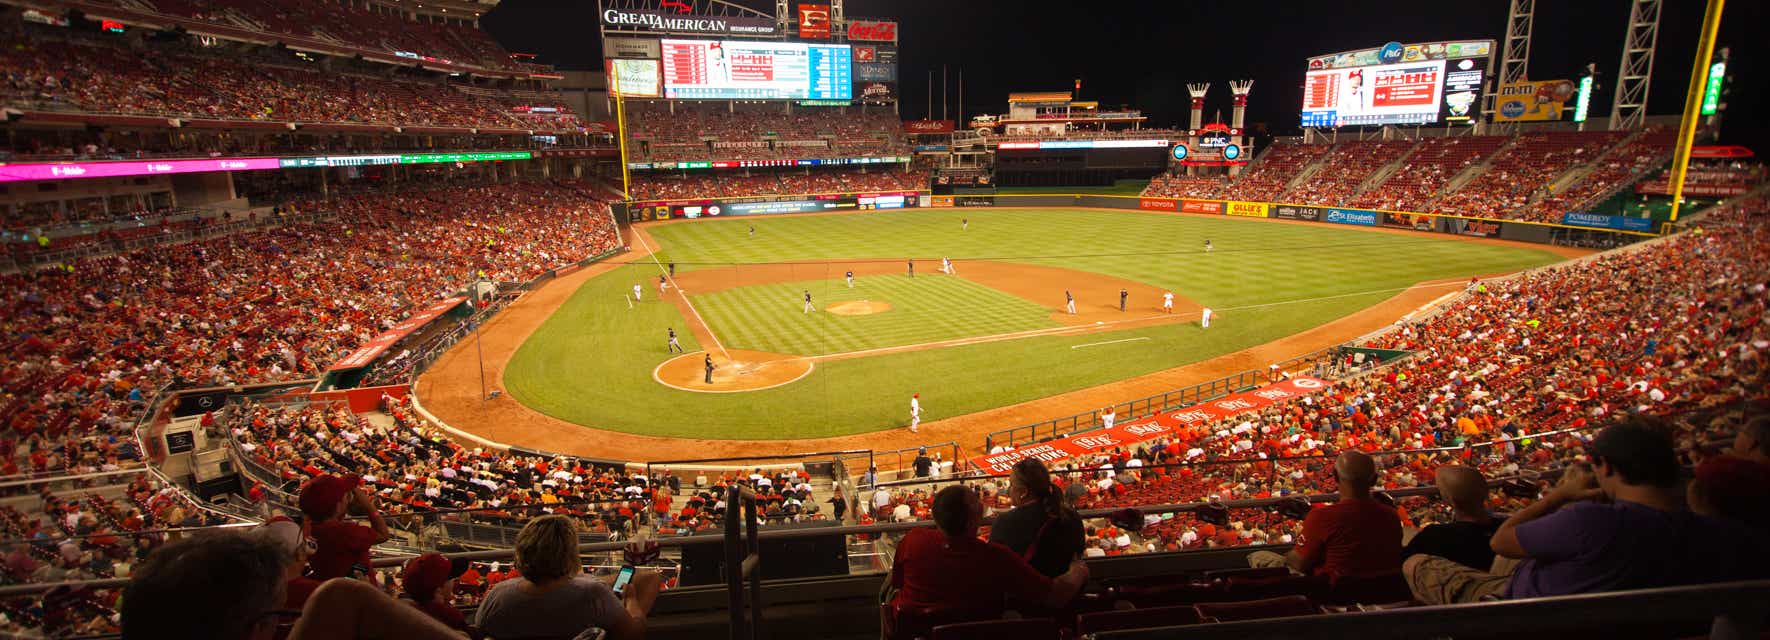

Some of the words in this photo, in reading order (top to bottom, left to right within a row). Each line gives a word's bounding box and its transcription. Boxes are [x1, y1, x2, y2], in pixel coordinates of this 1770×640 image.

[603, 9, 657, 25] GREAT
[651, 15, 727, 31] AMERICAN
[1383, 48, 1402, 58] P&G
[1210, 137, 1226, 145] PNC
[984, 452, 1021, 464] WORLD
[1020, 445, 1054, 457] SERIES
[991, 449, 1069, 473] CHAIONS
